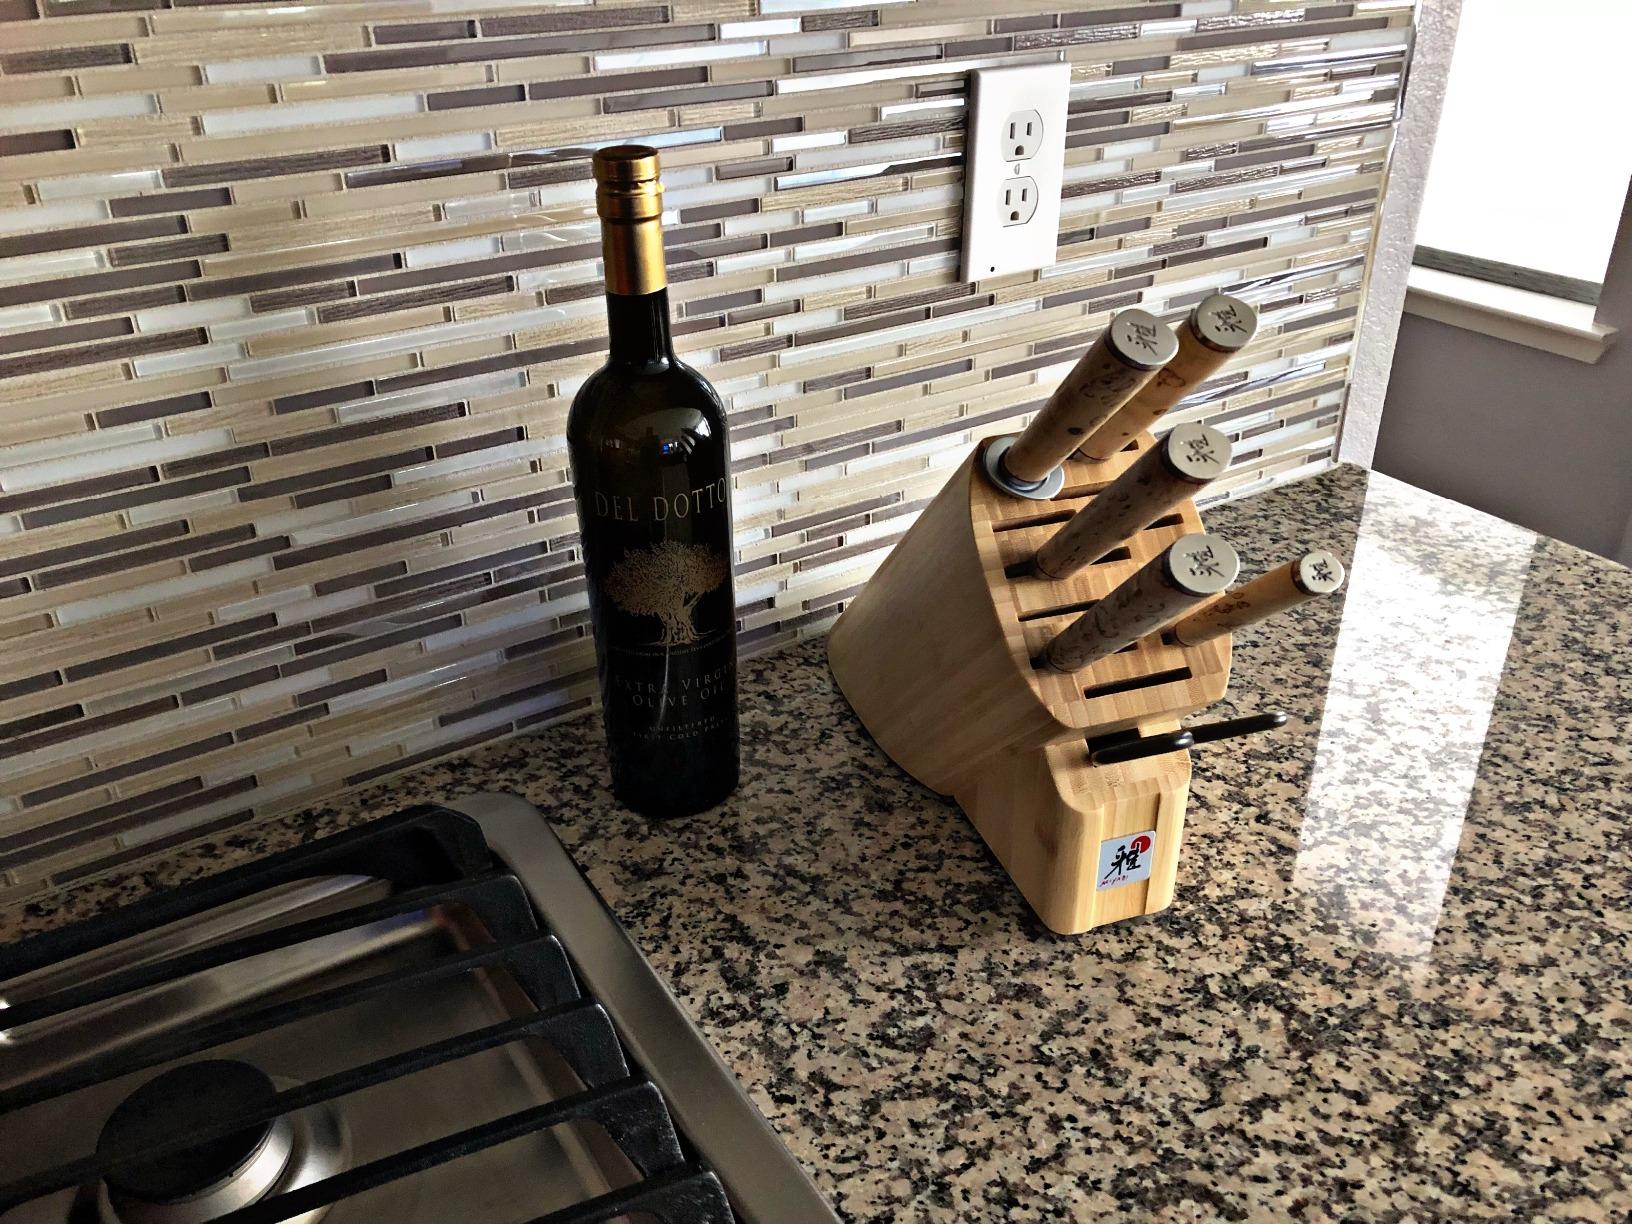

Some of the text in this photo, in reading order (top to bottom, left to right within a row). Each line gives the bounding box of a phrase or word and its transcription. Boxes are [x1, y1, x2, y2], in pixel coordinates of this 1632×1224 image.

[593, 476, 727, 522] DEL DOTTO
[632, 680, 728, 708] OLIVE OIL
